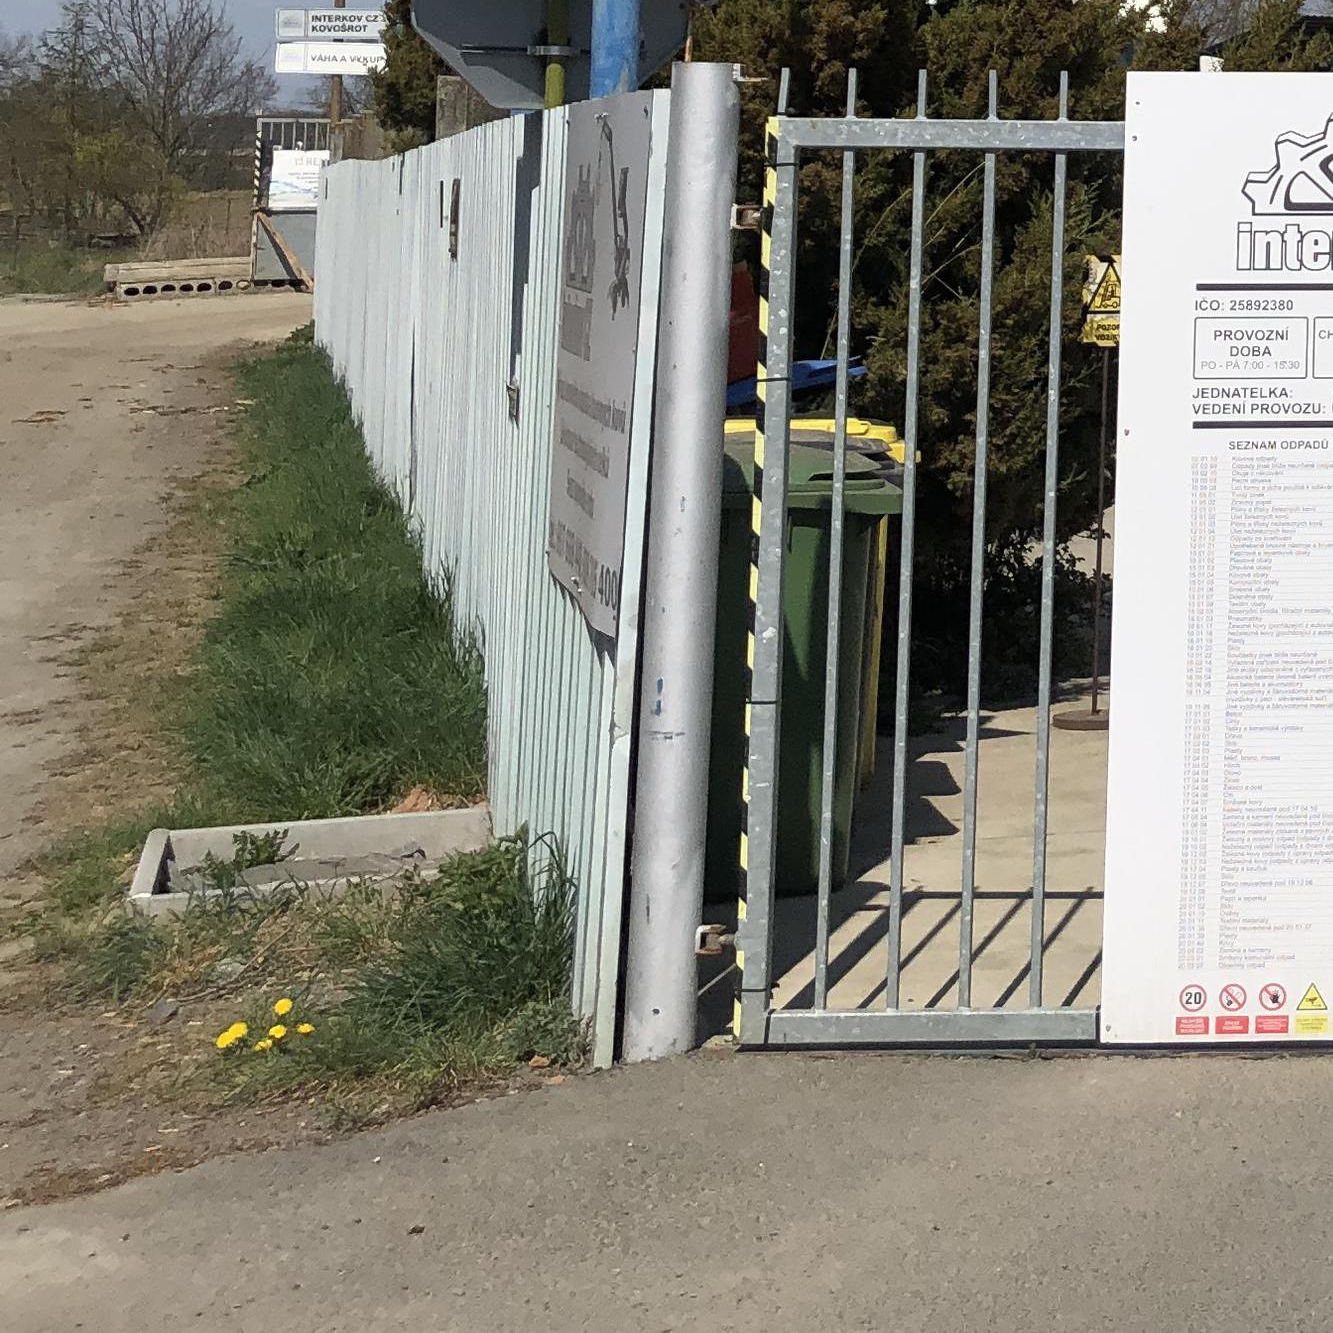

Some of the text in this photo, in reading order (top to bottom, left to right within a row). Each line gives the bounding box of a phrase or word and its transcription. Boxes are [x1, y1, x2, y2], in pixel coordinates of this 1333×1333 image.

[311, 14, 379, 23] INTERKOV CZ
[311, 22, 368, 33] KOVOŠROT
[311, 53, 338, 62] VÁHA
[1194, 296, 1294, 311] IČO: 25892380
[1213, 326, 1290, 341] PROVOZNÍ
[1229, 346, 1272, 357] DOBA
[1201, 360, 1216, 370] PO
[1225, 359, 1241, 370] PÁ
[1192, 387, 1294, 399] JEDNATELKA:
[1192, 401, 1246, 415] VEDENÍ
[1250, 403, 1326, 415] PROVOZU:
[1228, 439, 1278, 451] SEZNAM
[1280, 437, 1329, 450] ODPADŮ
[1184, 990, 1203, 1006] 20
